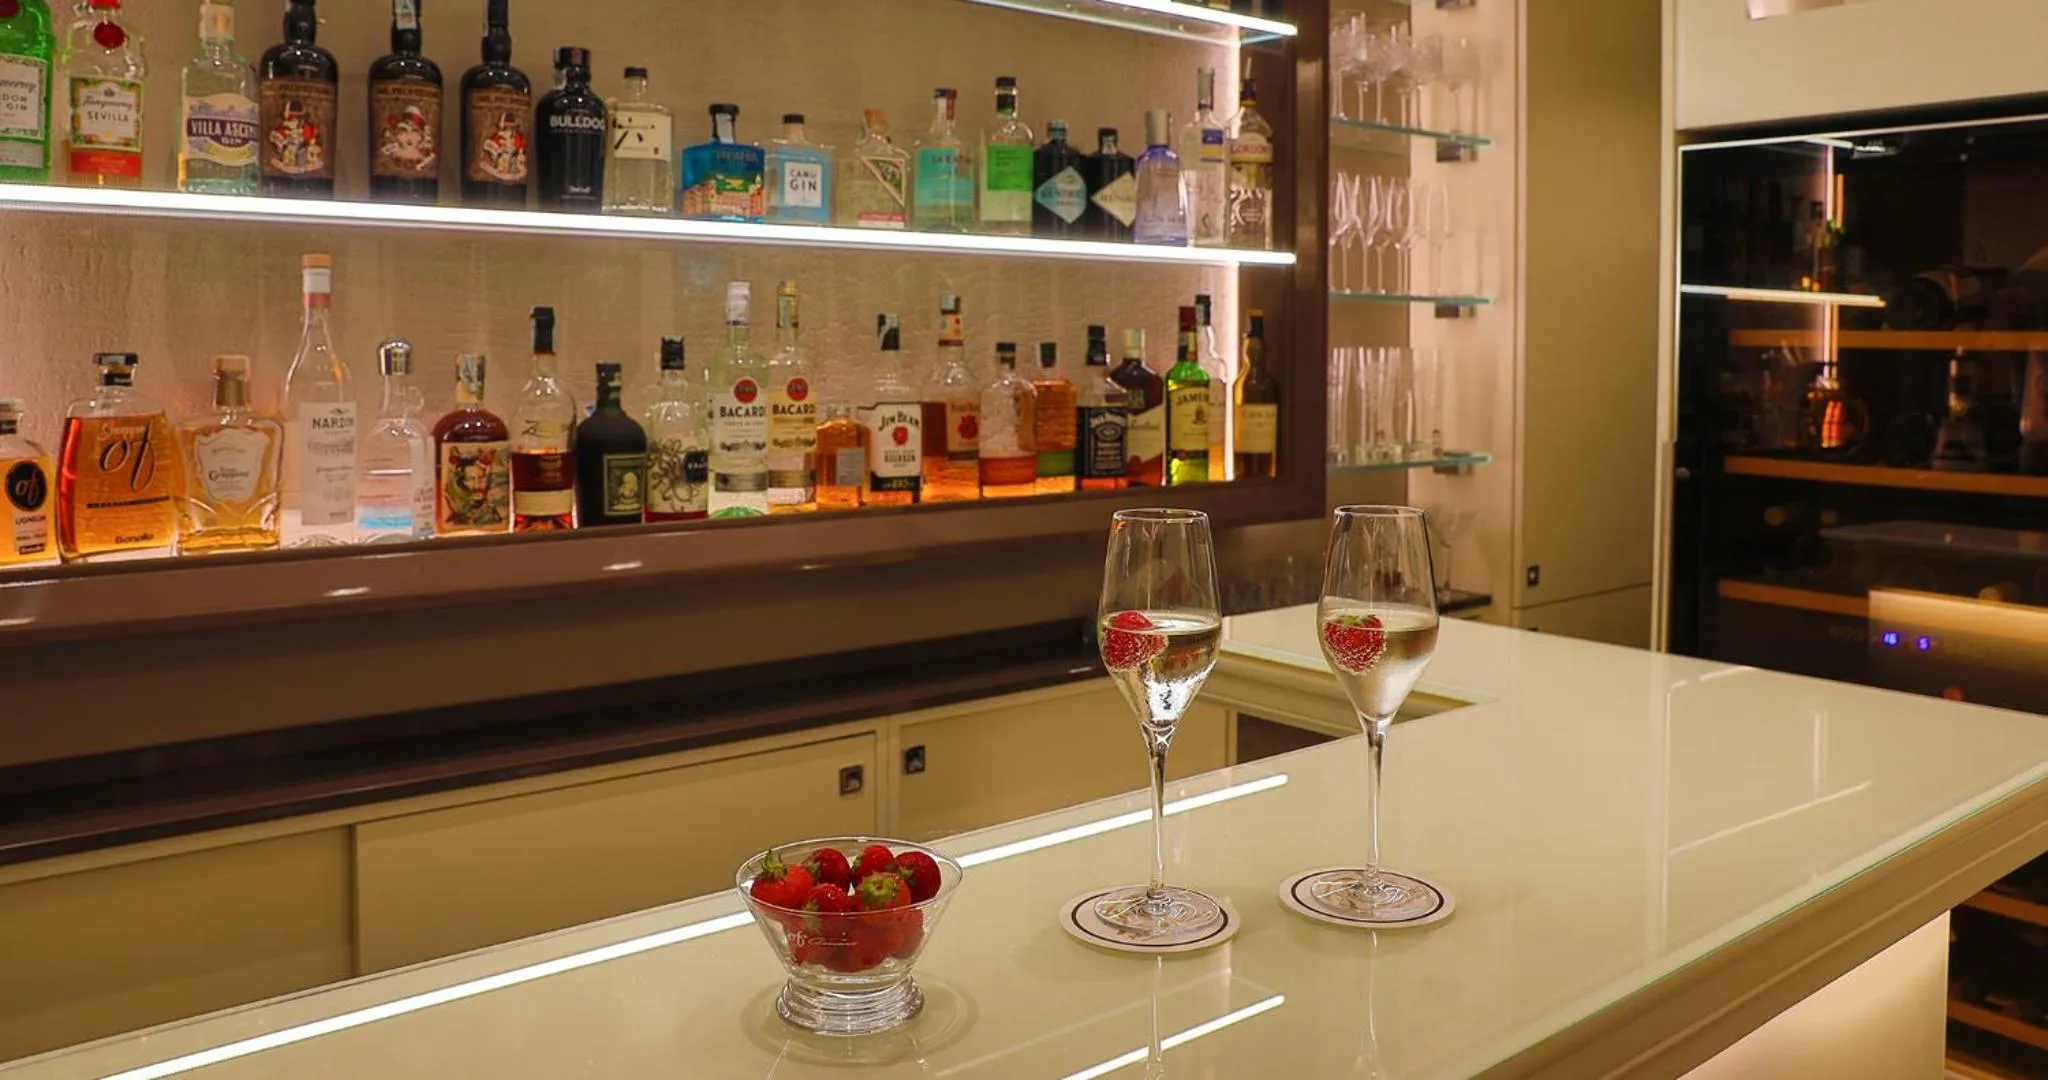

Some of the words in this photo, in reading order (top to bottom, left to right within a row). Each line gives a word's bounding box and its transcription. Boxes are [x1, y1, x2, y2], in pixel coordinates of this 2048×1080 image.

[6, 102, 28, 111] GIN
[87, 111, 129, 122] SEVILLA
[191, 119, 221, 136] VILLA
[789, 179, 818, 192] GIN
[879, 415, 896, 431] JIM
[897, 411, 920, 427] BEAM
[15, 470, 39, 506] of
